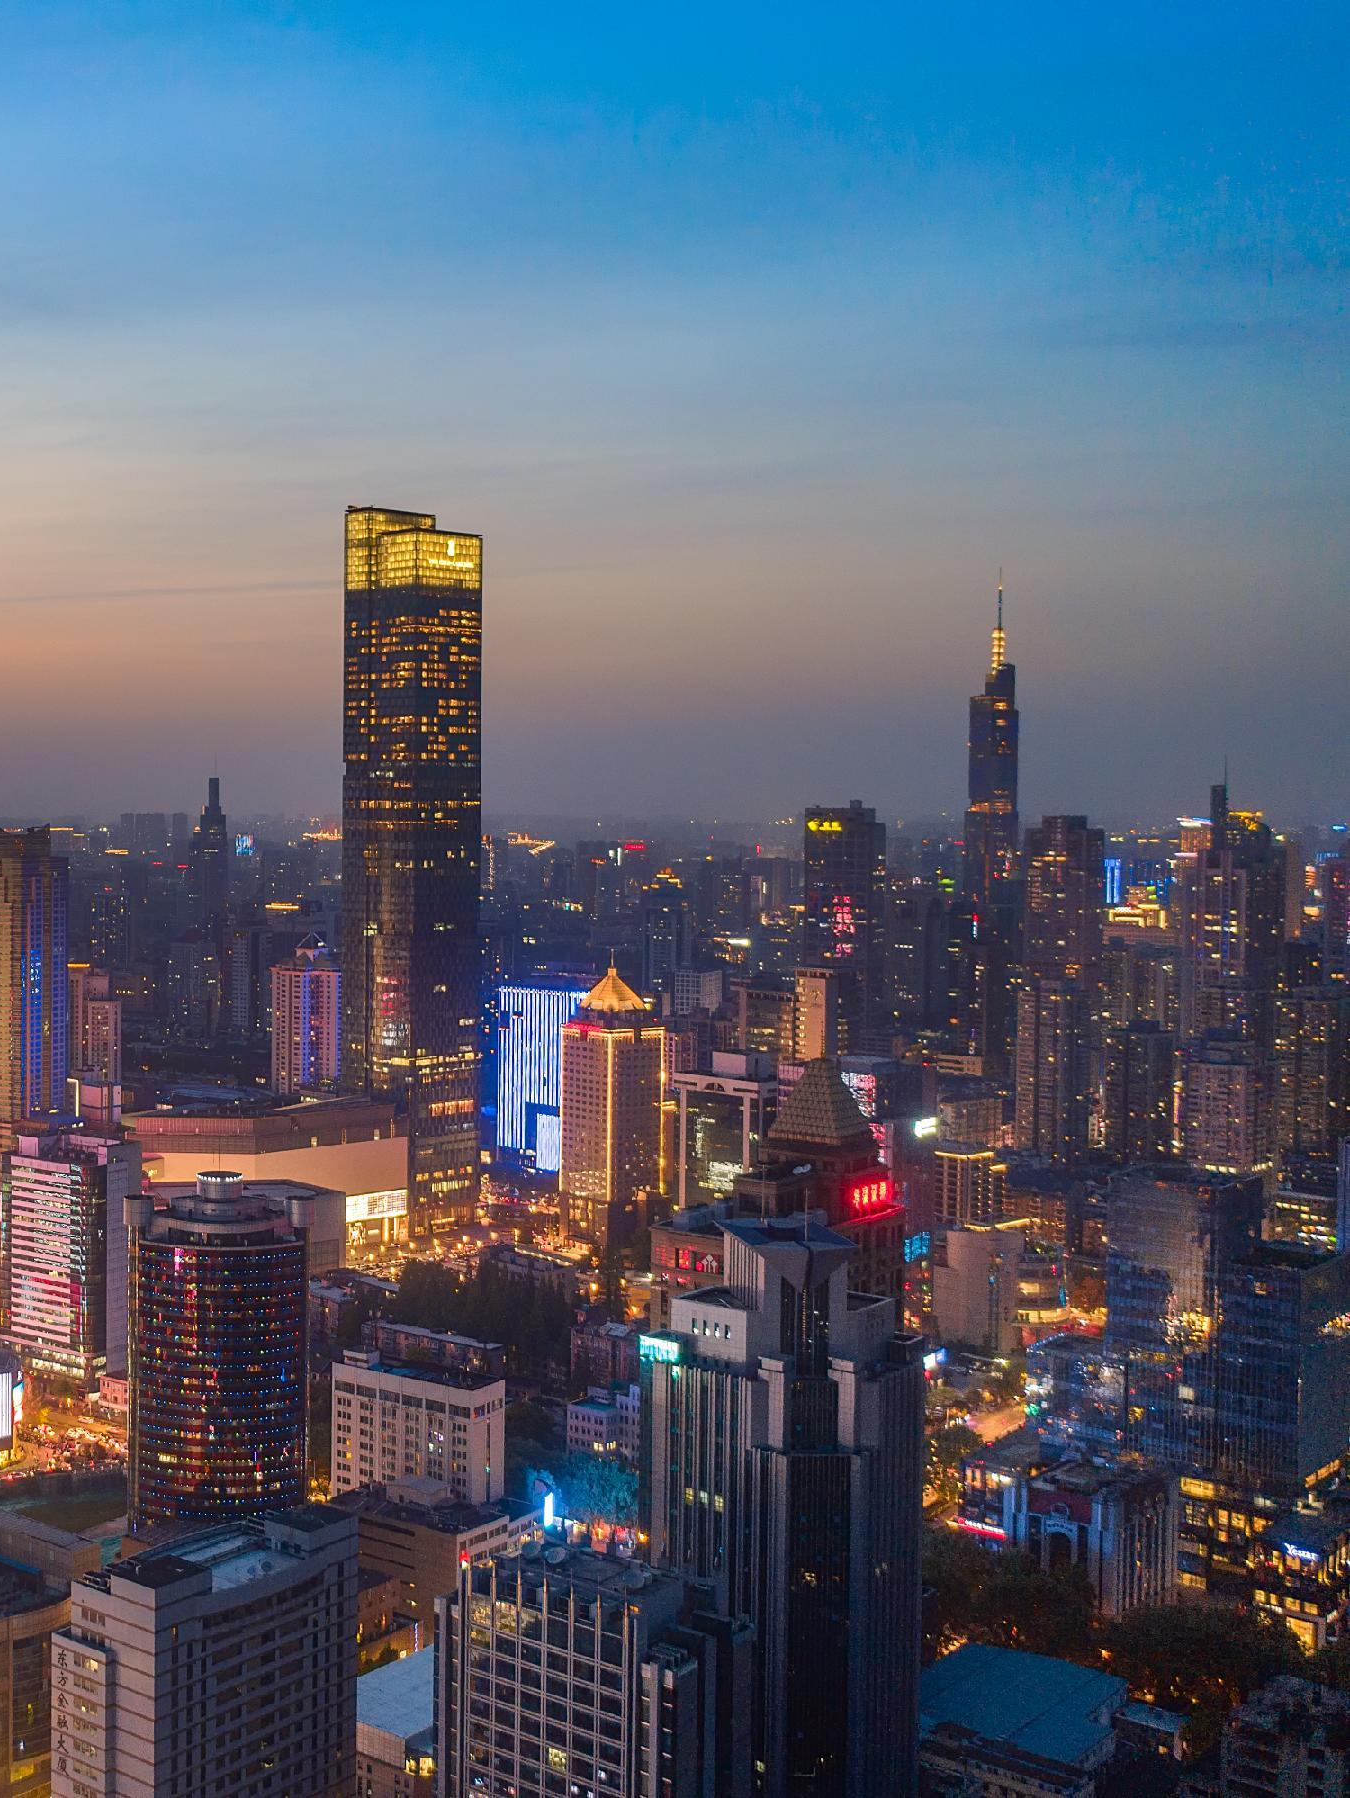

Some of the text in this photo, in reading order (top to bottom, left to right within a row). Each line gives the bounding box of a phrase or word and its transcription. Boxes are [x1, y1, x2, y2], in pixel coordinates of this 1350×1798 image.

[57, 1649, 69, 1777] 东方金融大厦
